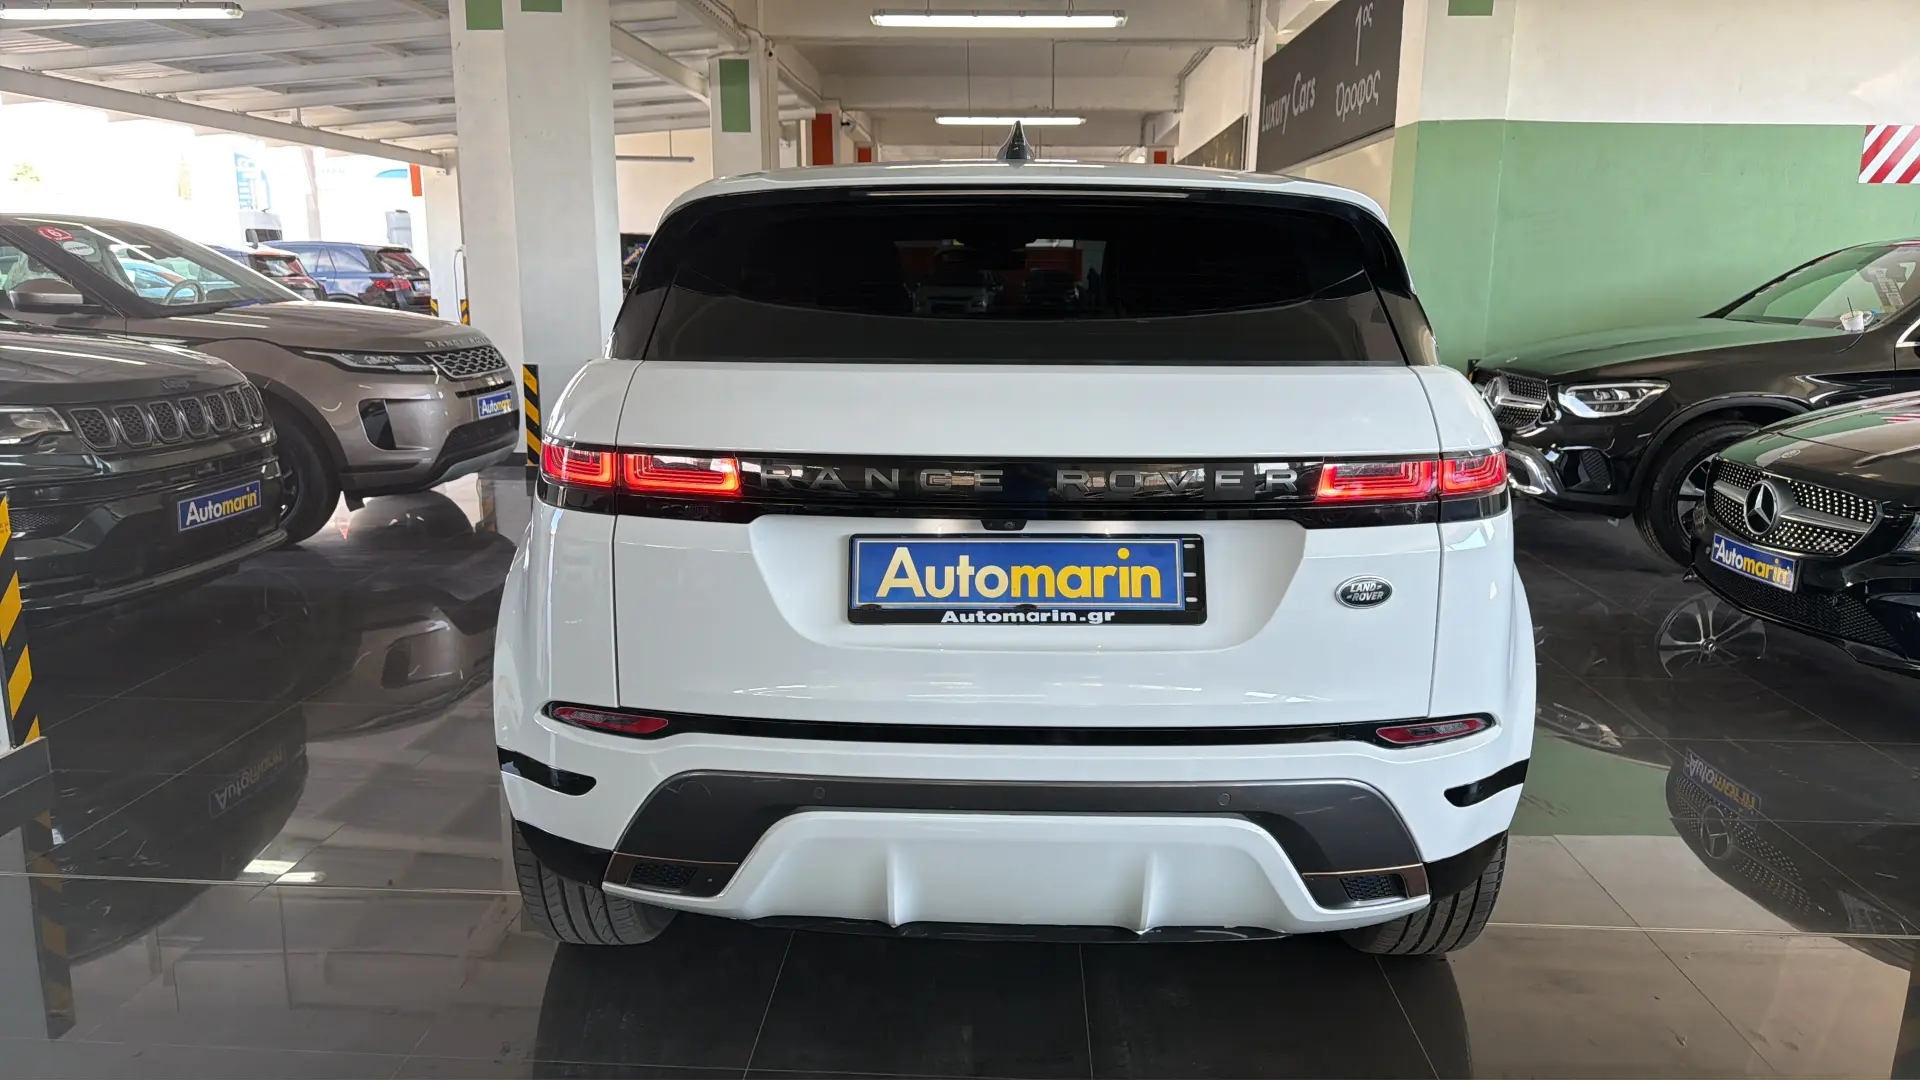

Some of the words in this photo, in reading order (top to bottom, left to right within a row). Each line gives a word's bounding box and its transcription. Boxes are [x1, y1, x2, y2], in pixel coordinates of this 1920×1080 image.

[1261, 93, 1291, 135] Luxury
[1292, 71, 1316, 117] Cars
[759, 463, 1003, 492] RANGE
[1056, 468, 1299, 491] ROVER
[186, 486, 258, 526] Automarin
[876, 546, 1162, 598] Automarin
[1715, 539, 1788, 585] Automarin
[1350, 582, 1377, 592] LAND
[1352, 591, 1384, 602] ROVER
[940, 608, 1116, 625] Automarin.gr
